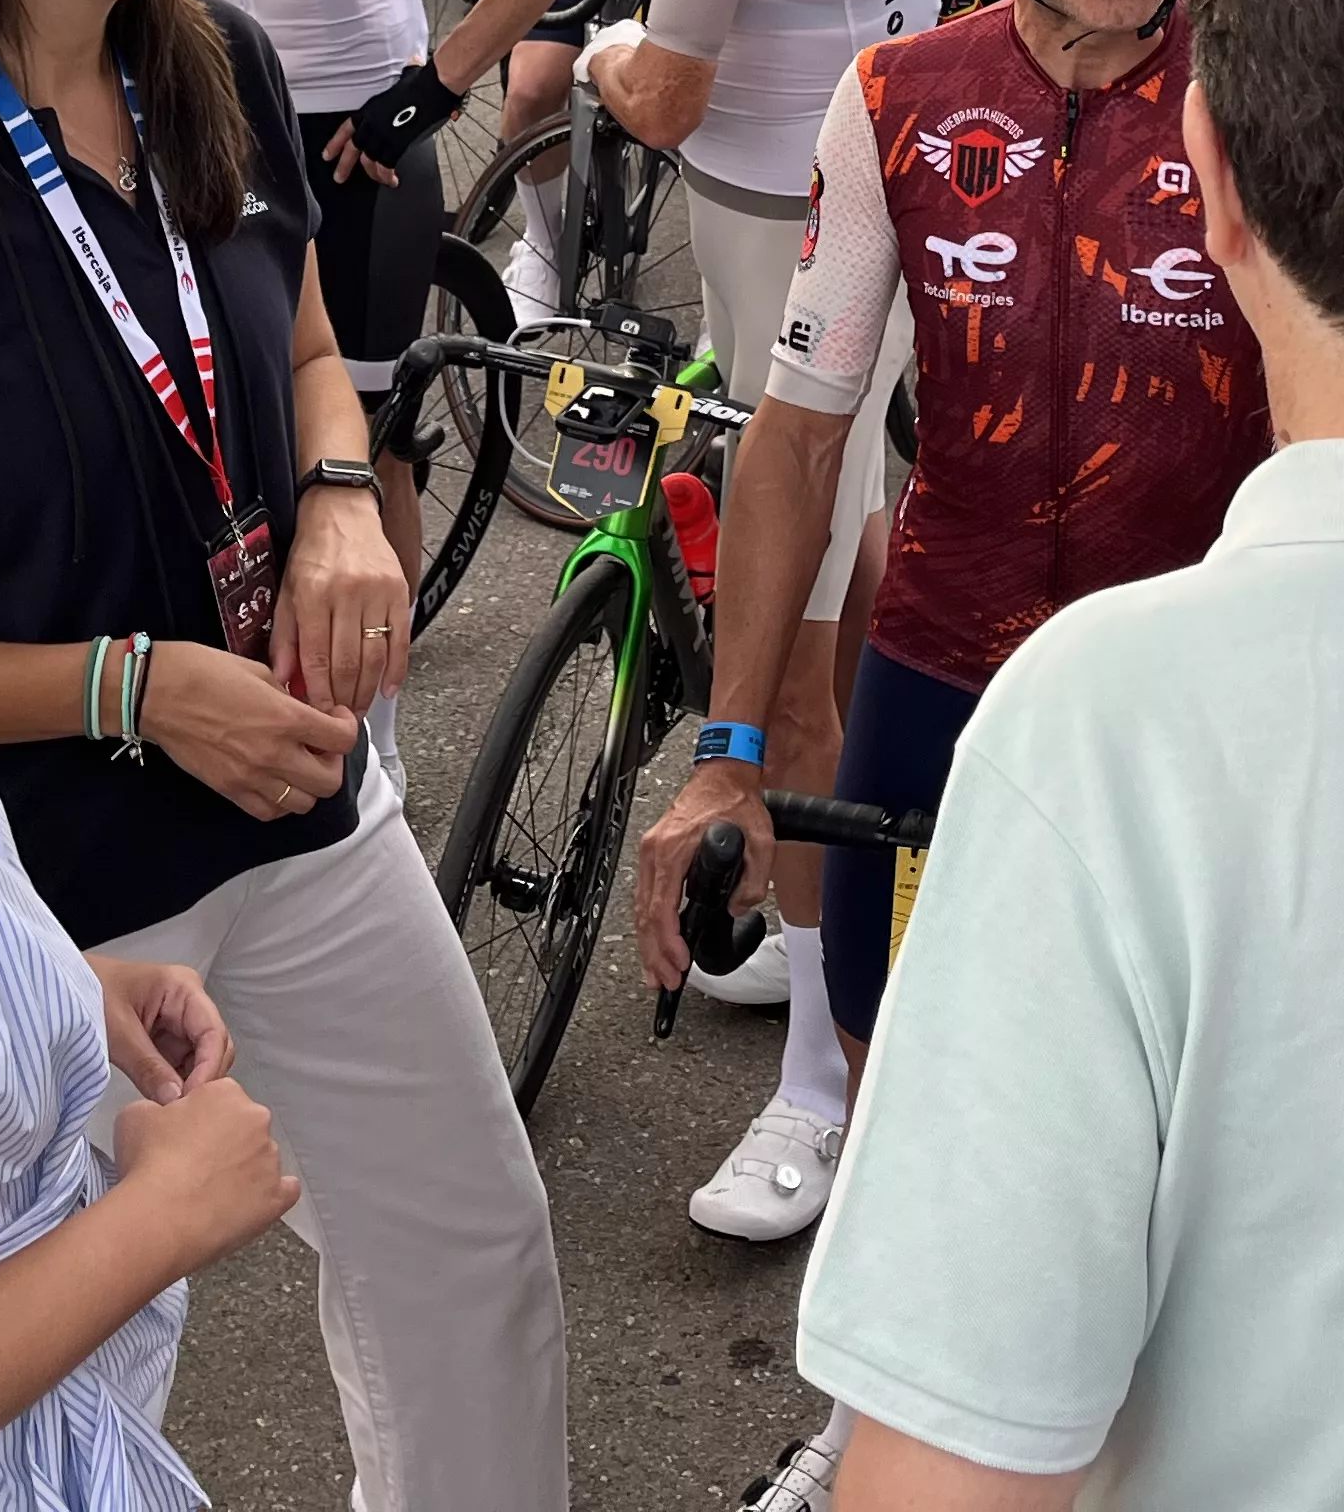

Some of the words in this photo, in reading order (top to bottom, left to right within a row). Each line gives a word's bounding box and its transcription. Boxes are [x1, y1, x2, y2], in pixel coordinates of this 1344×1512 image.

[937, 107, 1024, 140] QUEBRANTAHUESOS
[72, 226, 113, 294] Ibercaja
[922, 281, 1015, 308] TotalEnergies
[1120, 303, 1225, 331] Ibercaja
[571, 435, 637, 477] 290
[422, 567, 449, 616] DT
[450, 489, 492, 572] SWISS
